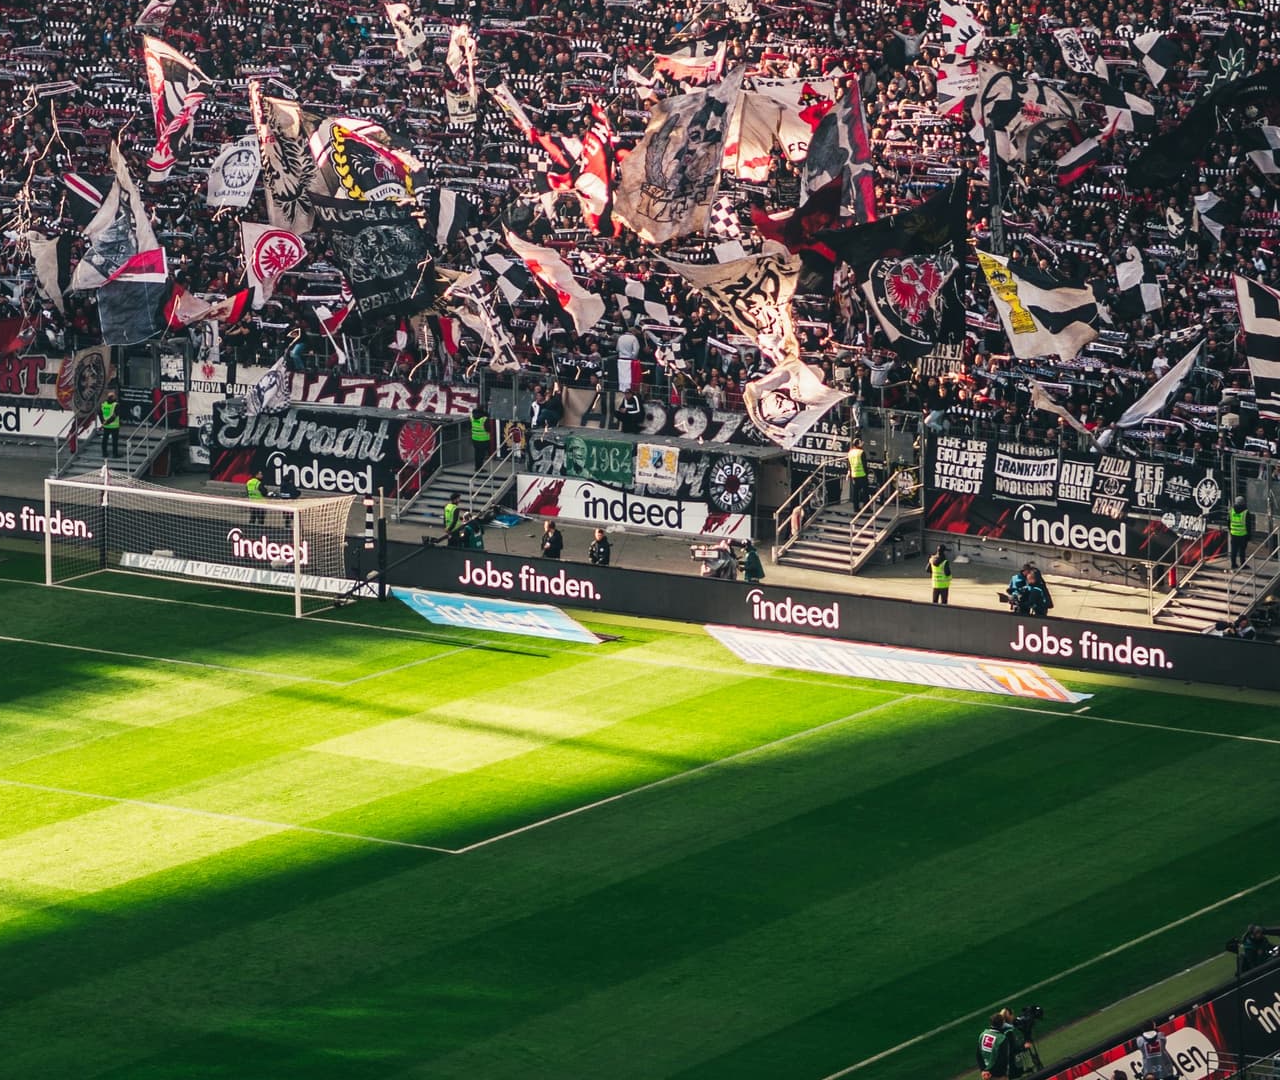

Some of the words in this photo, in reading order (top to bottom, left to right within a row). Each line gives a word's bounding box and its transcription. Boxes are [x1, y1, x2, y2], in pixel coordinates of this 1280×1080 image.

[216, 404, 390, 463] Eintracht
[274, 455, 373, 496] indeed
[996, 457, 1056, 477] FRANKFURT
[1059, 463, 1095, 487] RIED
[1097, 455, 1132, 477] FULDA
[934, 474, 983, 495] VERBOT
[995, 477, 1054, 497] HOOLIGANS
[1058, 484, 1091, 502] GEBIET
[20, 505, 94, 539] finden.
[583, 491, 684, 530] indeed
[233, 531, 309, 566] indeed
[1022, 510, 1127, 556] indeed
[138, 555, 185, 573] VERIMI
[203, 563, 252, 581] VERIMI
[458, 559, 514, 590] Jobs
[519, 564, 602, 601] finden.
[753, 597, 840, 630] indeed
[1009, 624, 1074, 658] Jobs
[1078, 629, 1174, 670] finden.
